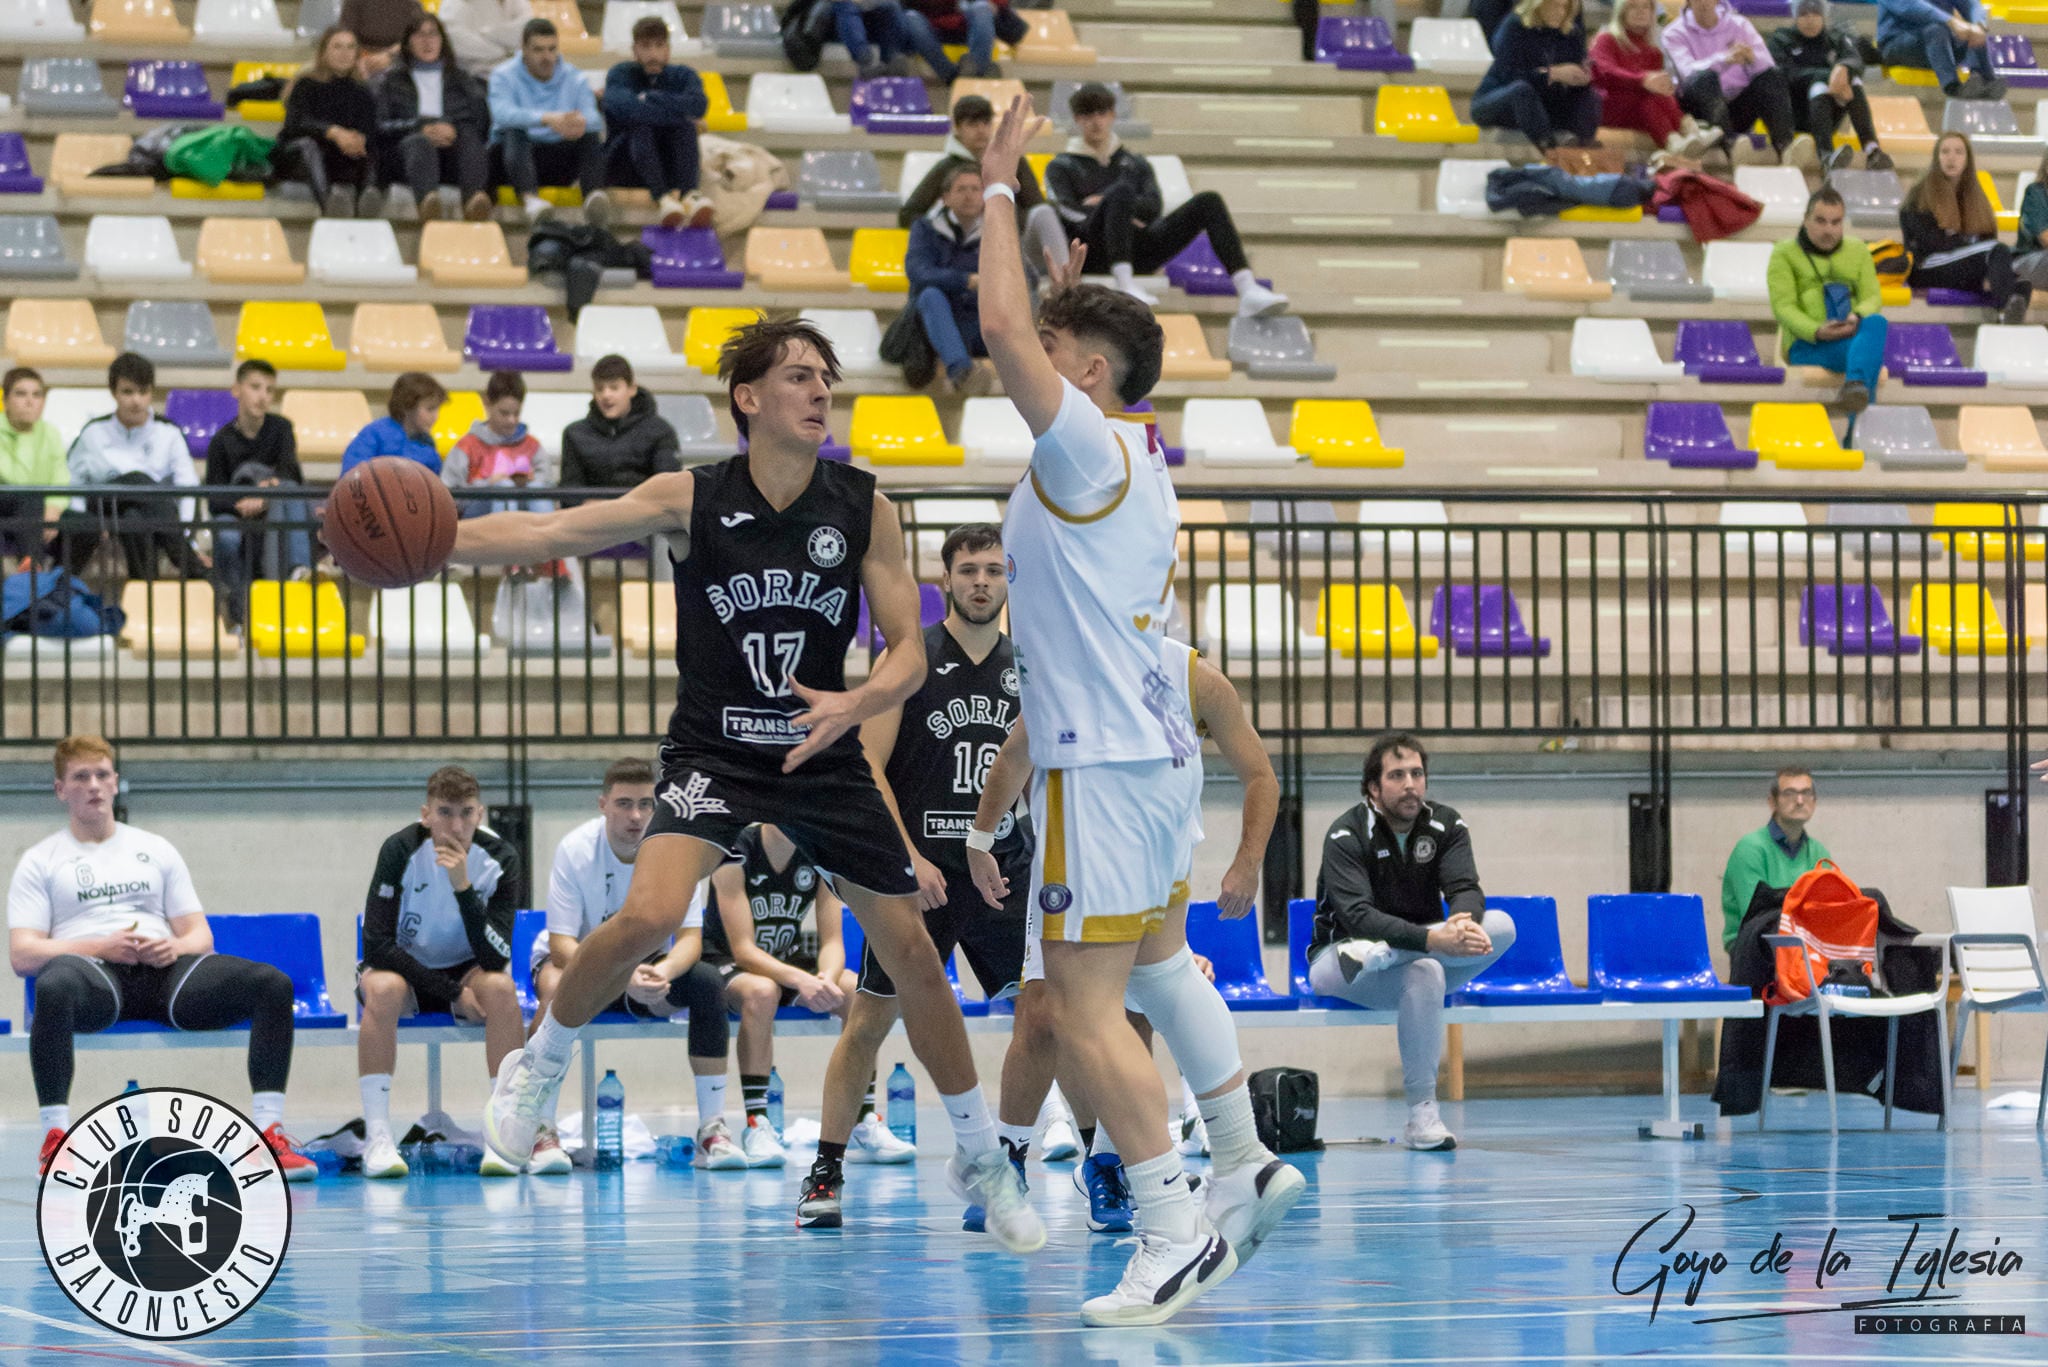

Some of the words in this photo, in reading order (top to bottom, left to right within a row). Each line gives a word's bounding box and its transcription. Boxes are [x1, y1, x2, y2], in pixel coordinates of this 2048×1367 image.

[706, 569, 848, 626] SORIA
[742, 631, 806, 698] 17
[928, 818, 974, 831] TRANS
[77, 881, 151, 904] NOVATION
[751, 893, 813, 921] ORI
